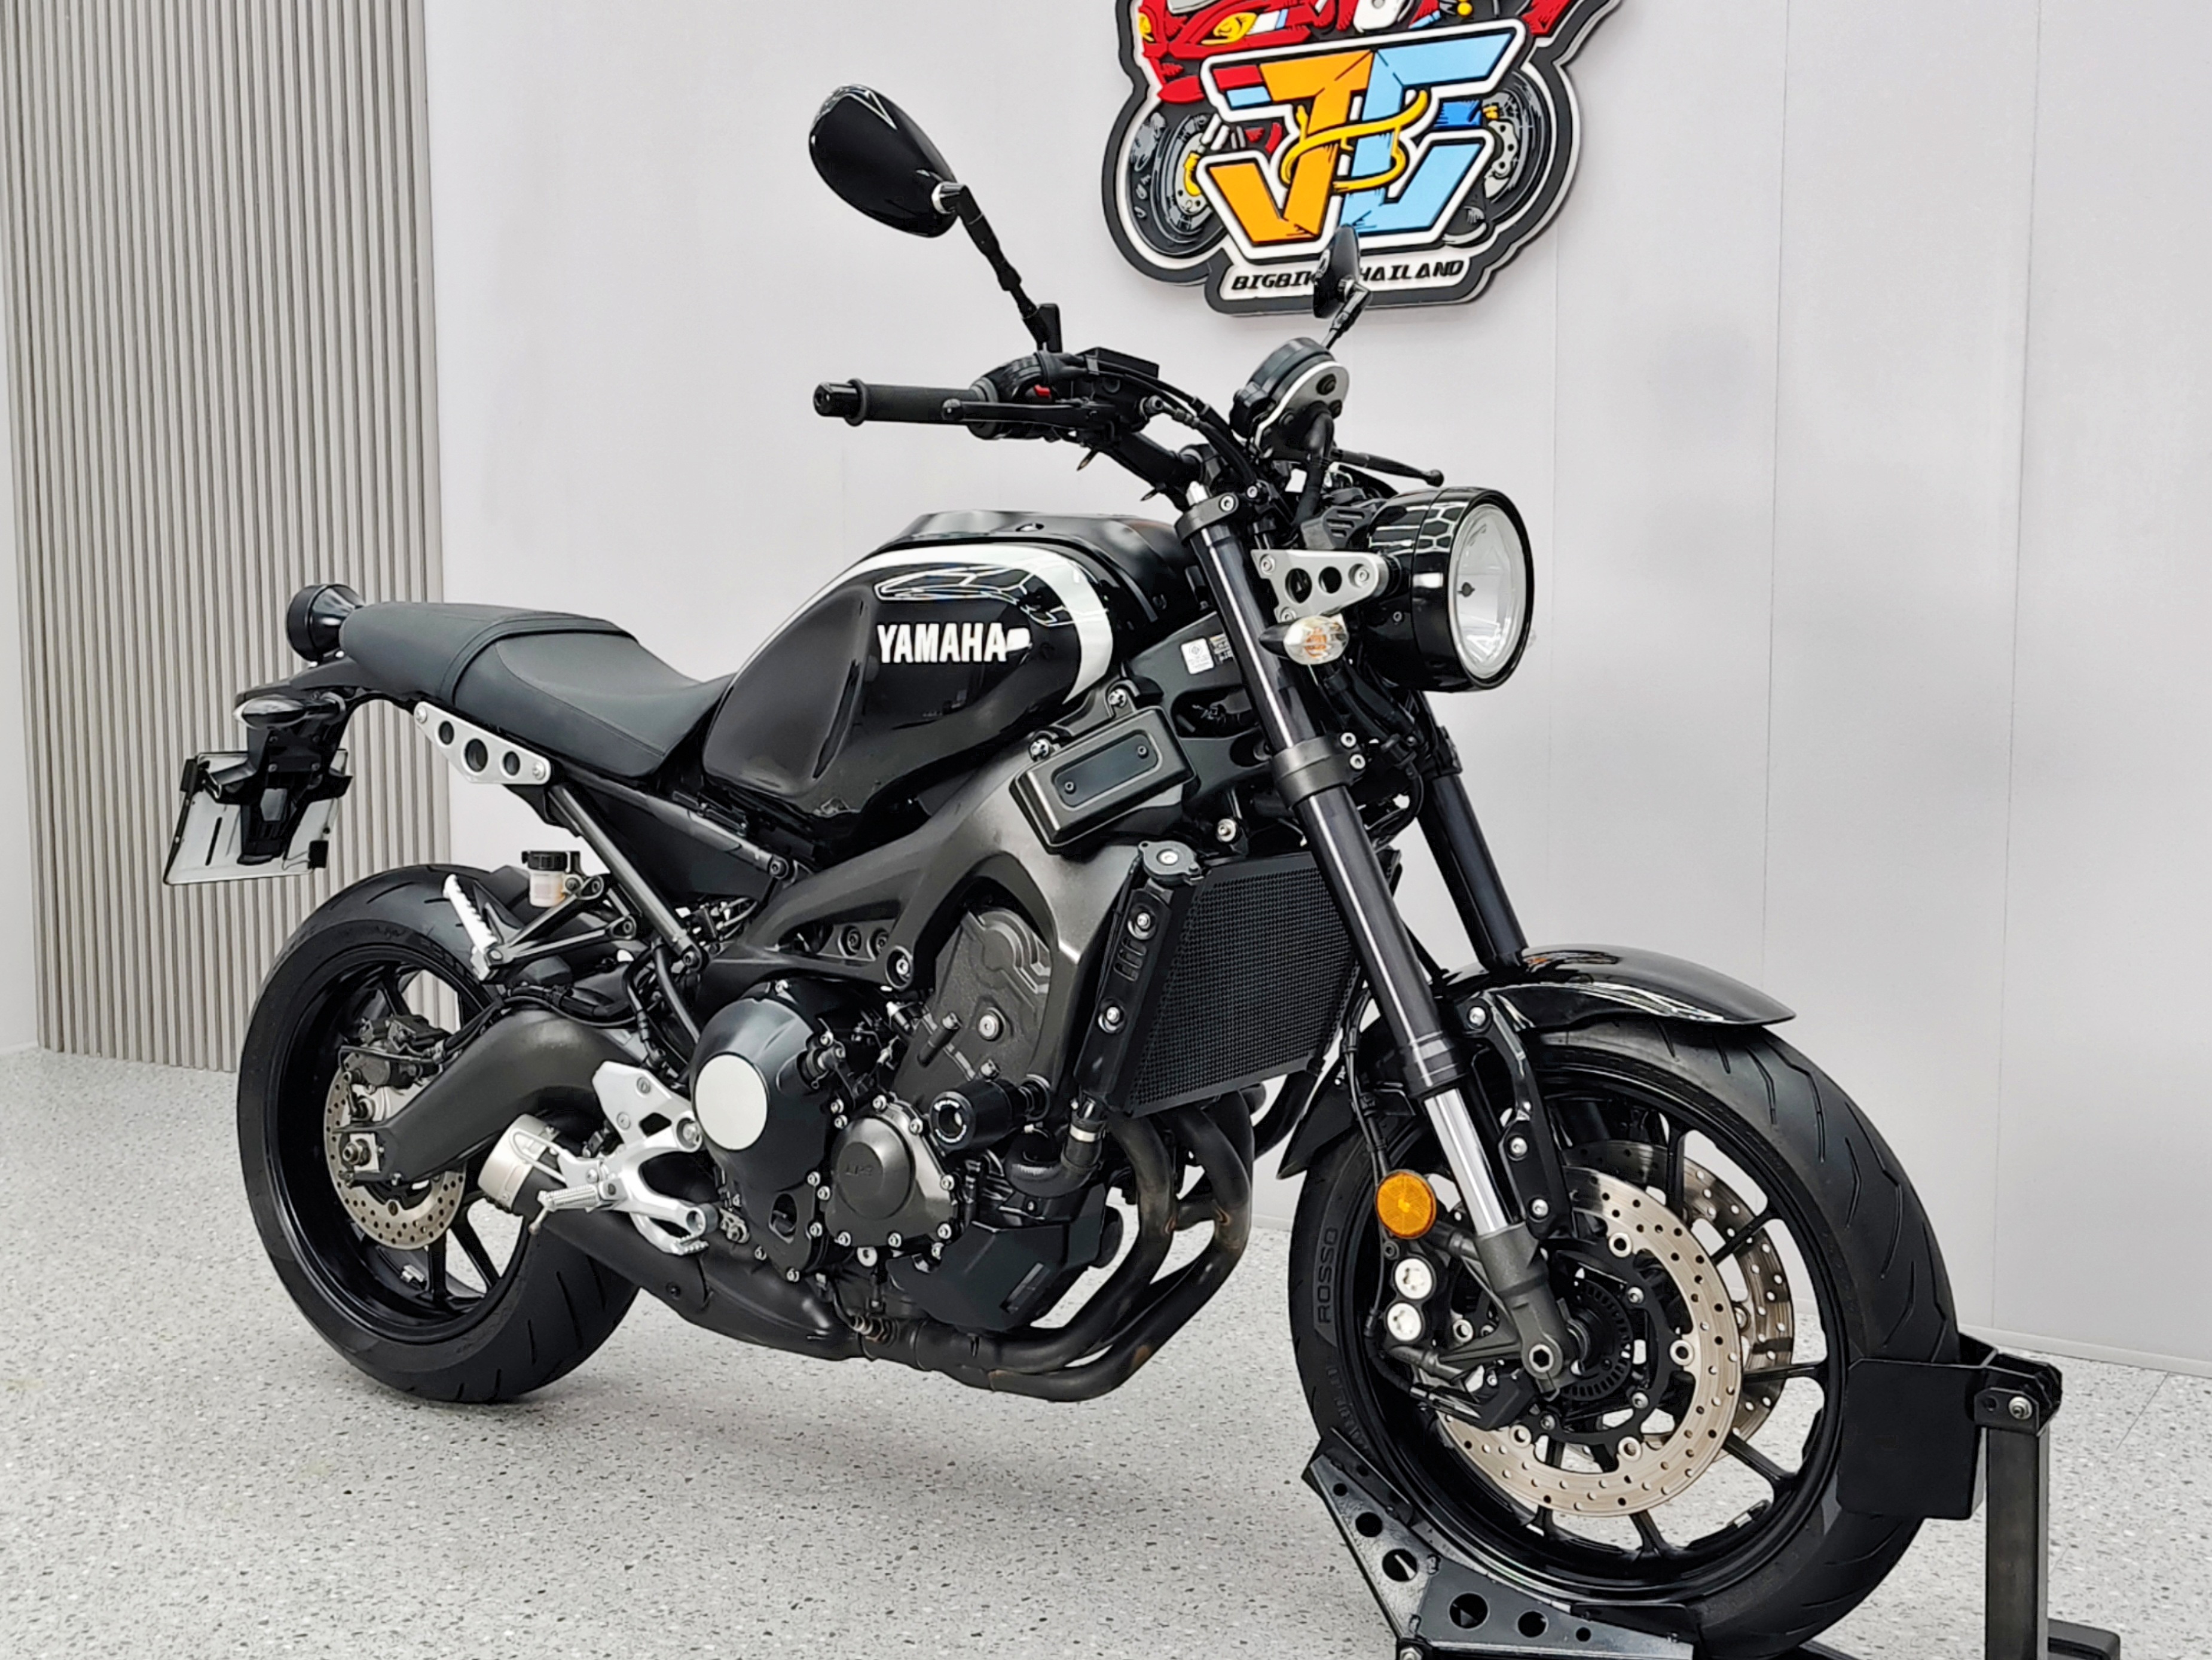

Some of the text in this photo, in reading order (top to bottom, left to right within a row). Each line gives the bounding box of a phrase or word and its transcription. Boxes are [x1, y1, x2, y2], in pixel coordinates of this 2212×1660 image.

[1360, 260, 1464, 282] HAILAND
[877, 622, 1007, 663] YAMAHA
[1316, 1228, 1339, 1323] ROSSO
